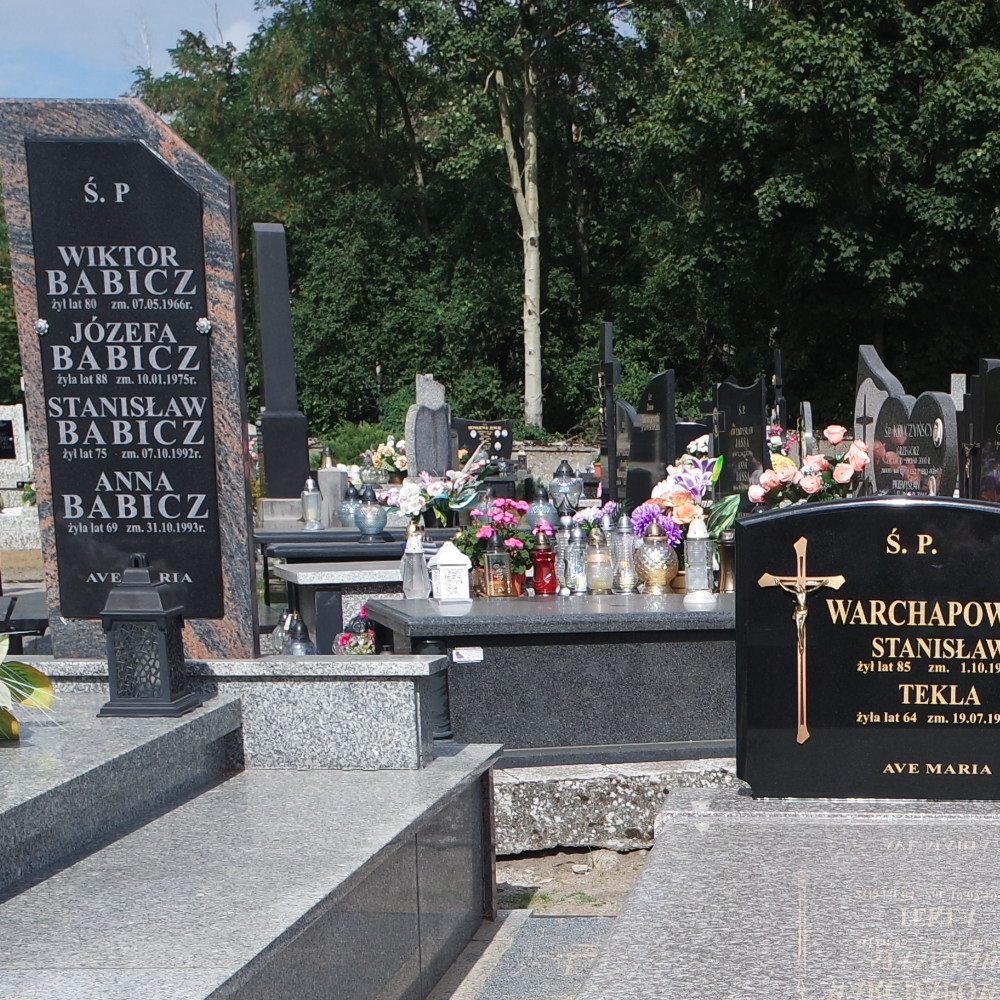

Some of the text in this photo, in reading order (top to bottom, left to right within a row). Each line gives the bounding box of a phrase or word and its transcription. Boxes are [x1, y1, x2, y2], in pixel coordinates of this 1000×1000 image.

[58, 246, 179, 266] WIKTOR
[46, 269, 196, 295] BABICZ
[69, 299, 81, 309] lat
[85, 299, 96, 309] 80
[133, 299, 192, 309] 07.05.1966r.
[70, 316, 177, 343] JÓZEFA
[50, 345, 200, 370] BABICZ
[80, 374, 93, 384] lat
[96, 374, 107, 384] 88
[138, 374, 196, 384] 10.01.1975r.
[49, 397, 207, 417] STANISŁAW
[56, 420, 204, 445] BABICZ
[80, 448, 92, 458] lat
[96, 448, 107, 458] 75
[142, 448, 201, 458] 07.10.1992r.
[95, 472, 173, 491] ANNA
[62, 494, 208, 518] BABICZ
[91, 523, 103, 532] lat
[107, 523, 117, 532] 69
[147, 522, 205, 532] 31.10.1993r.
[86, 573, 122, 583] AVE
[857, 661, 874, 674] żył
[878, 661, 893, 671] lat
[897, 661, 911, 672] 85
[899, 684, 980, 705] TEKLA
[857, 712, 880, 724] żyła
[884, 712, 899, 722] lat
[903, 712, 917, 722] 64
[928, 715, 948, 723] zm.
[883, 763, 992, 774] AVE MARIA
